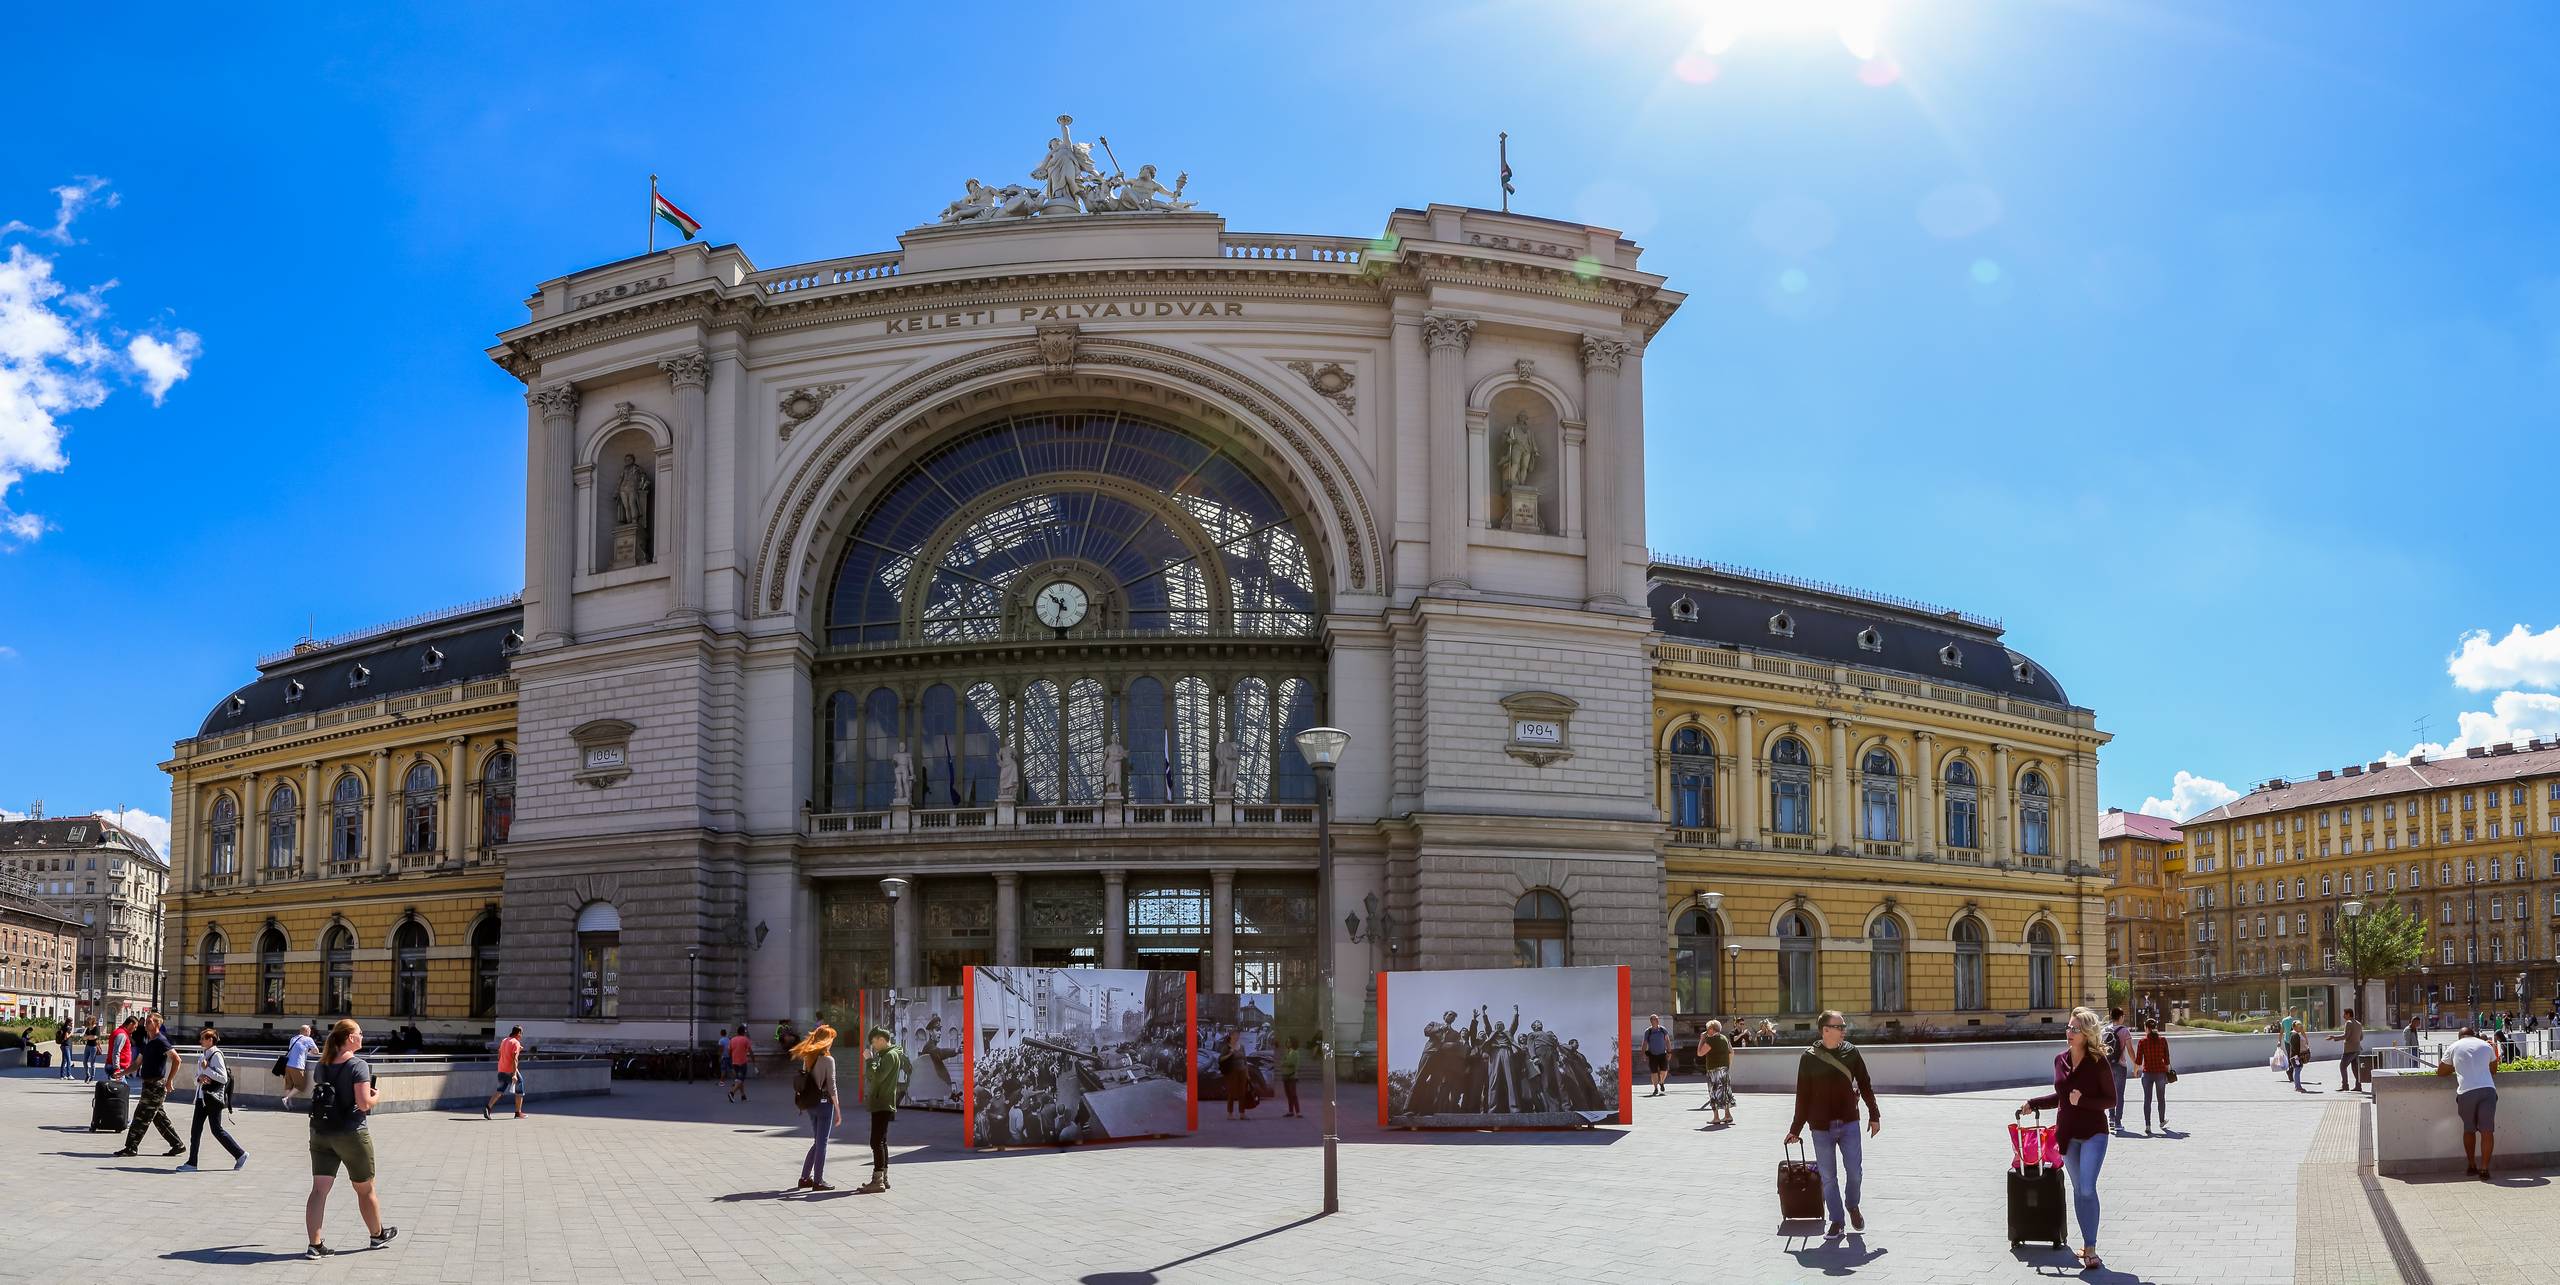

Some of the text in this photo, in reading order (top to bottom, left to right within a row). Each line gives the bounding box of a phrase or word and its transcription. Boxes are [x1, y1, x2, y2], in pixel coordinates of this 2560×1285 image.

[886, 302, 1243, 334] KELETI PÁLYAUDVAR
[1523, 724, 1552, 736] 1984
